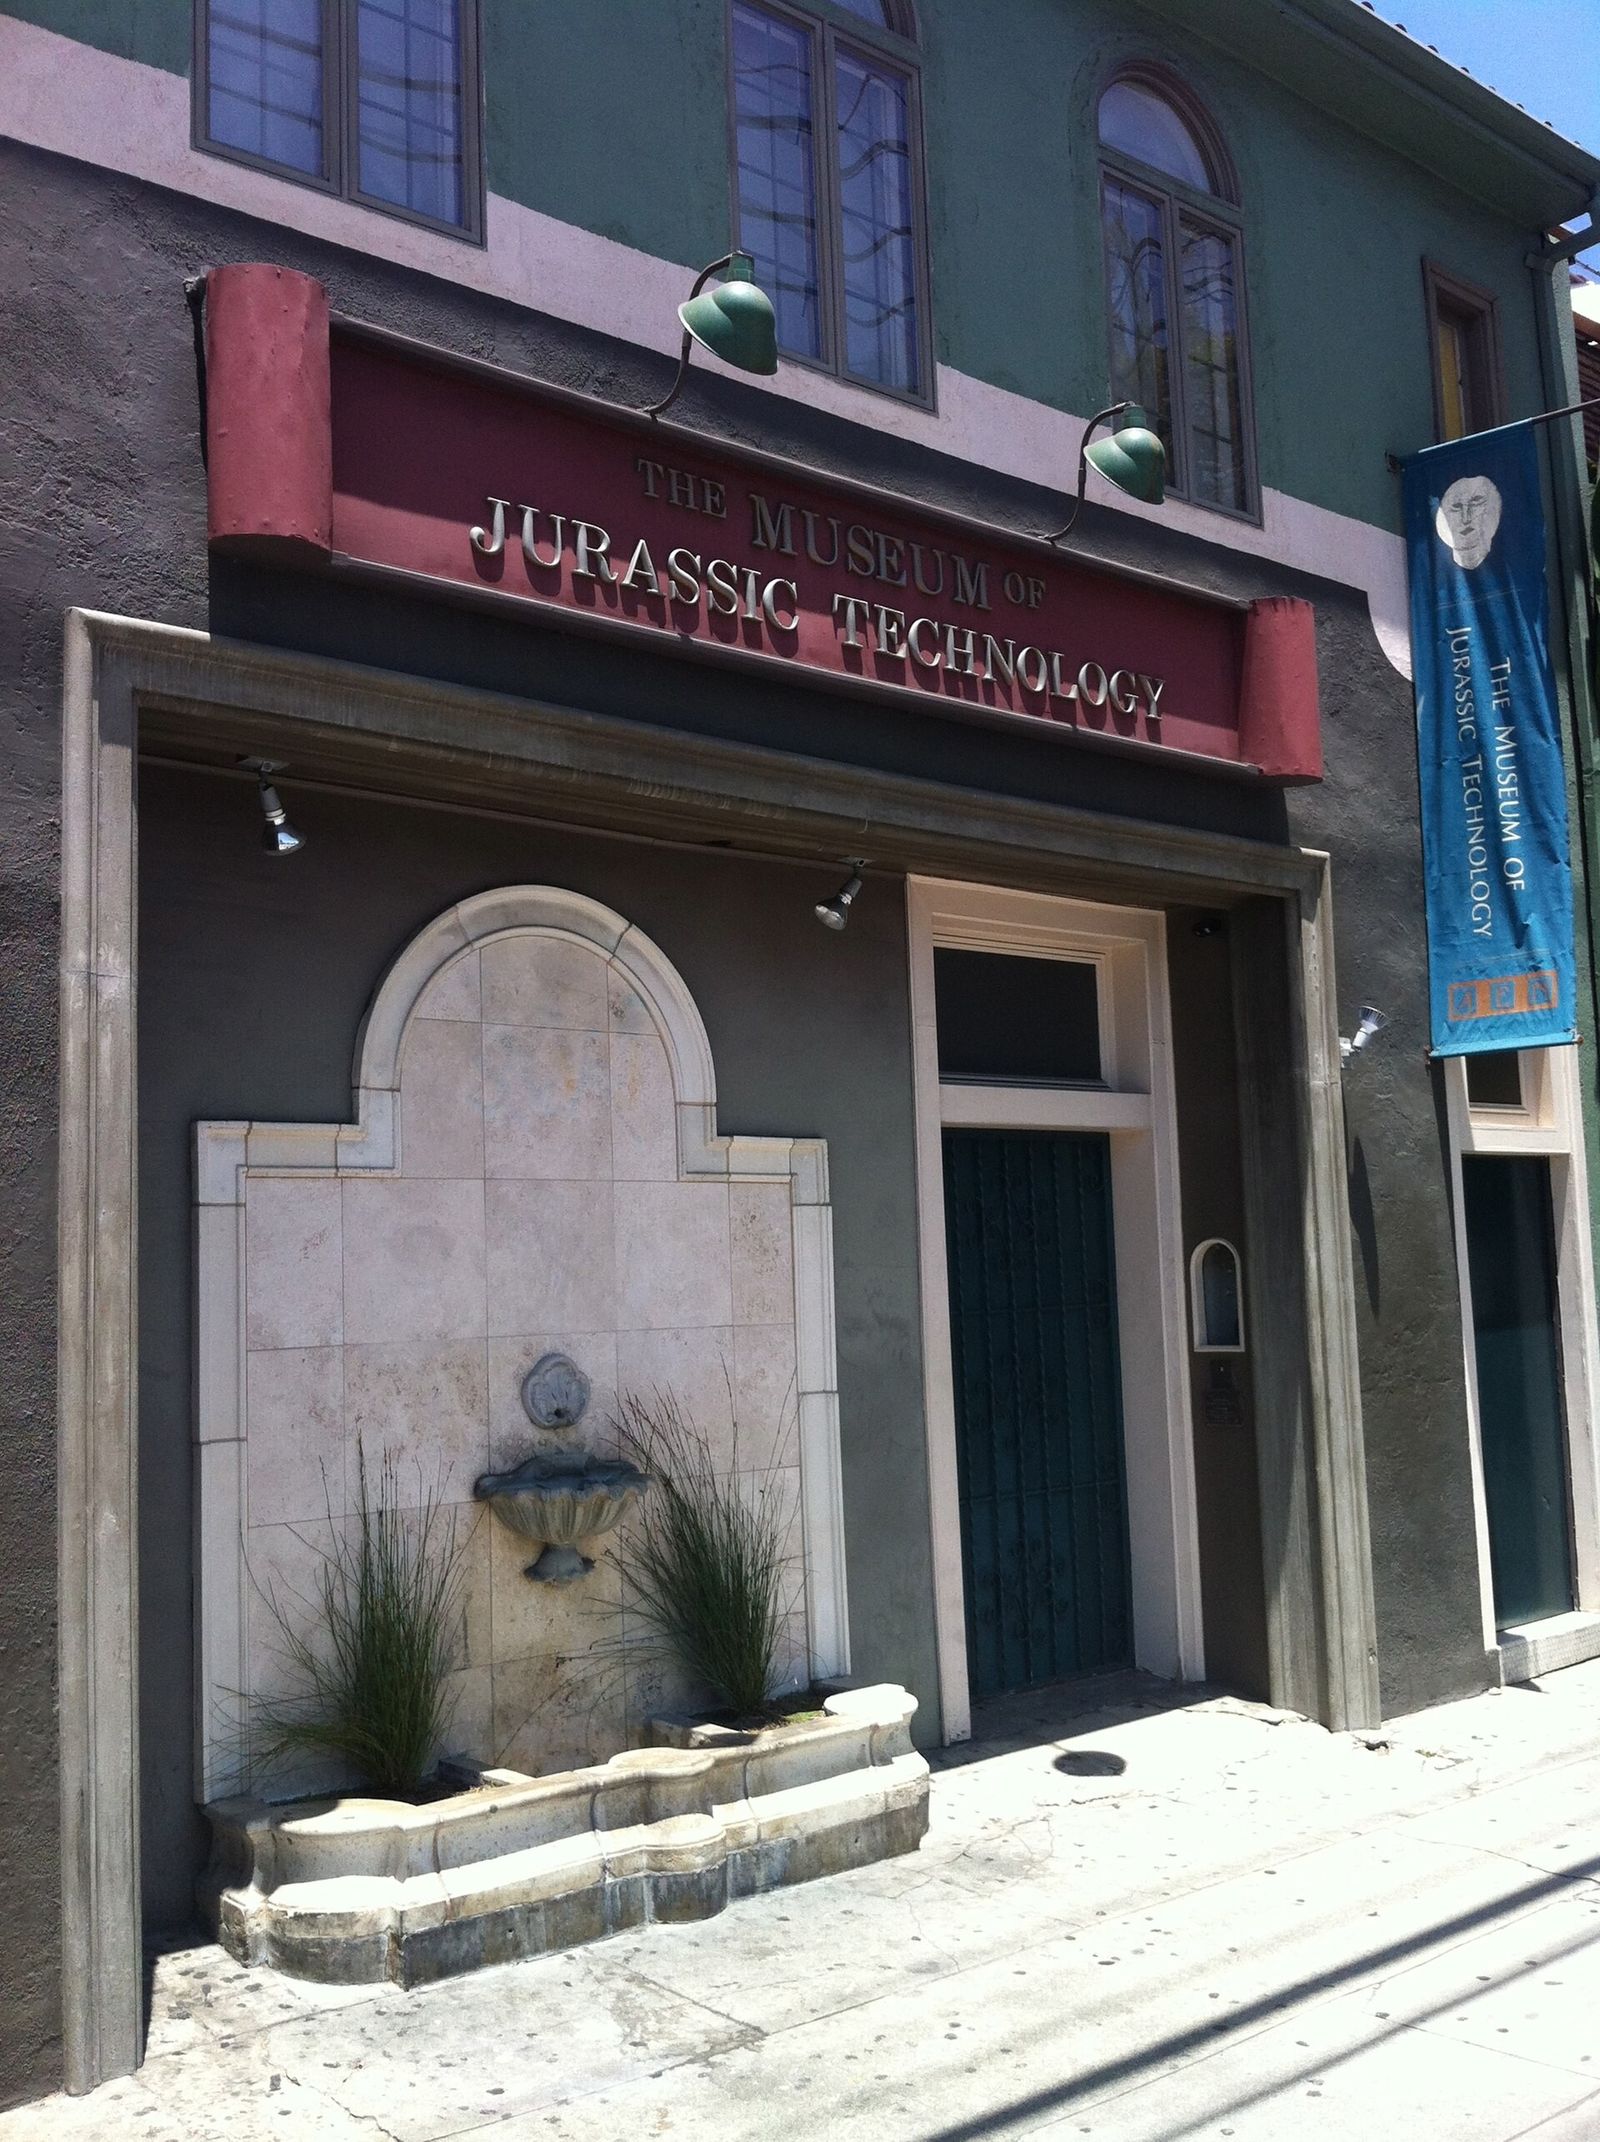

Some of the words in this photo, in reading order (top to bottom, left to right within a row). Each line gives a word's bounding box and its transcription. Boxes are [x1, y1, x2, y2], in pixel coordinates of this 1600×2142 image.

[636, 459, 728, 519] THE
[750, 493, 993, 611] MUSEUM
[1003, 571, 1047, 610] OF
[469, 496, 800, 633] JURASSIC
[832, 593, 1167, 721] TECHNOLOGY
[1490, 656, 1512, 711] THE
[1445, 626, 1477, 742] JURASSIC
[1461, 753, 1493, 937] TECHNOLOGY
[1494, 725, 1522, 842] MUSEUM
[1503, 857, 1526, 890] OF
